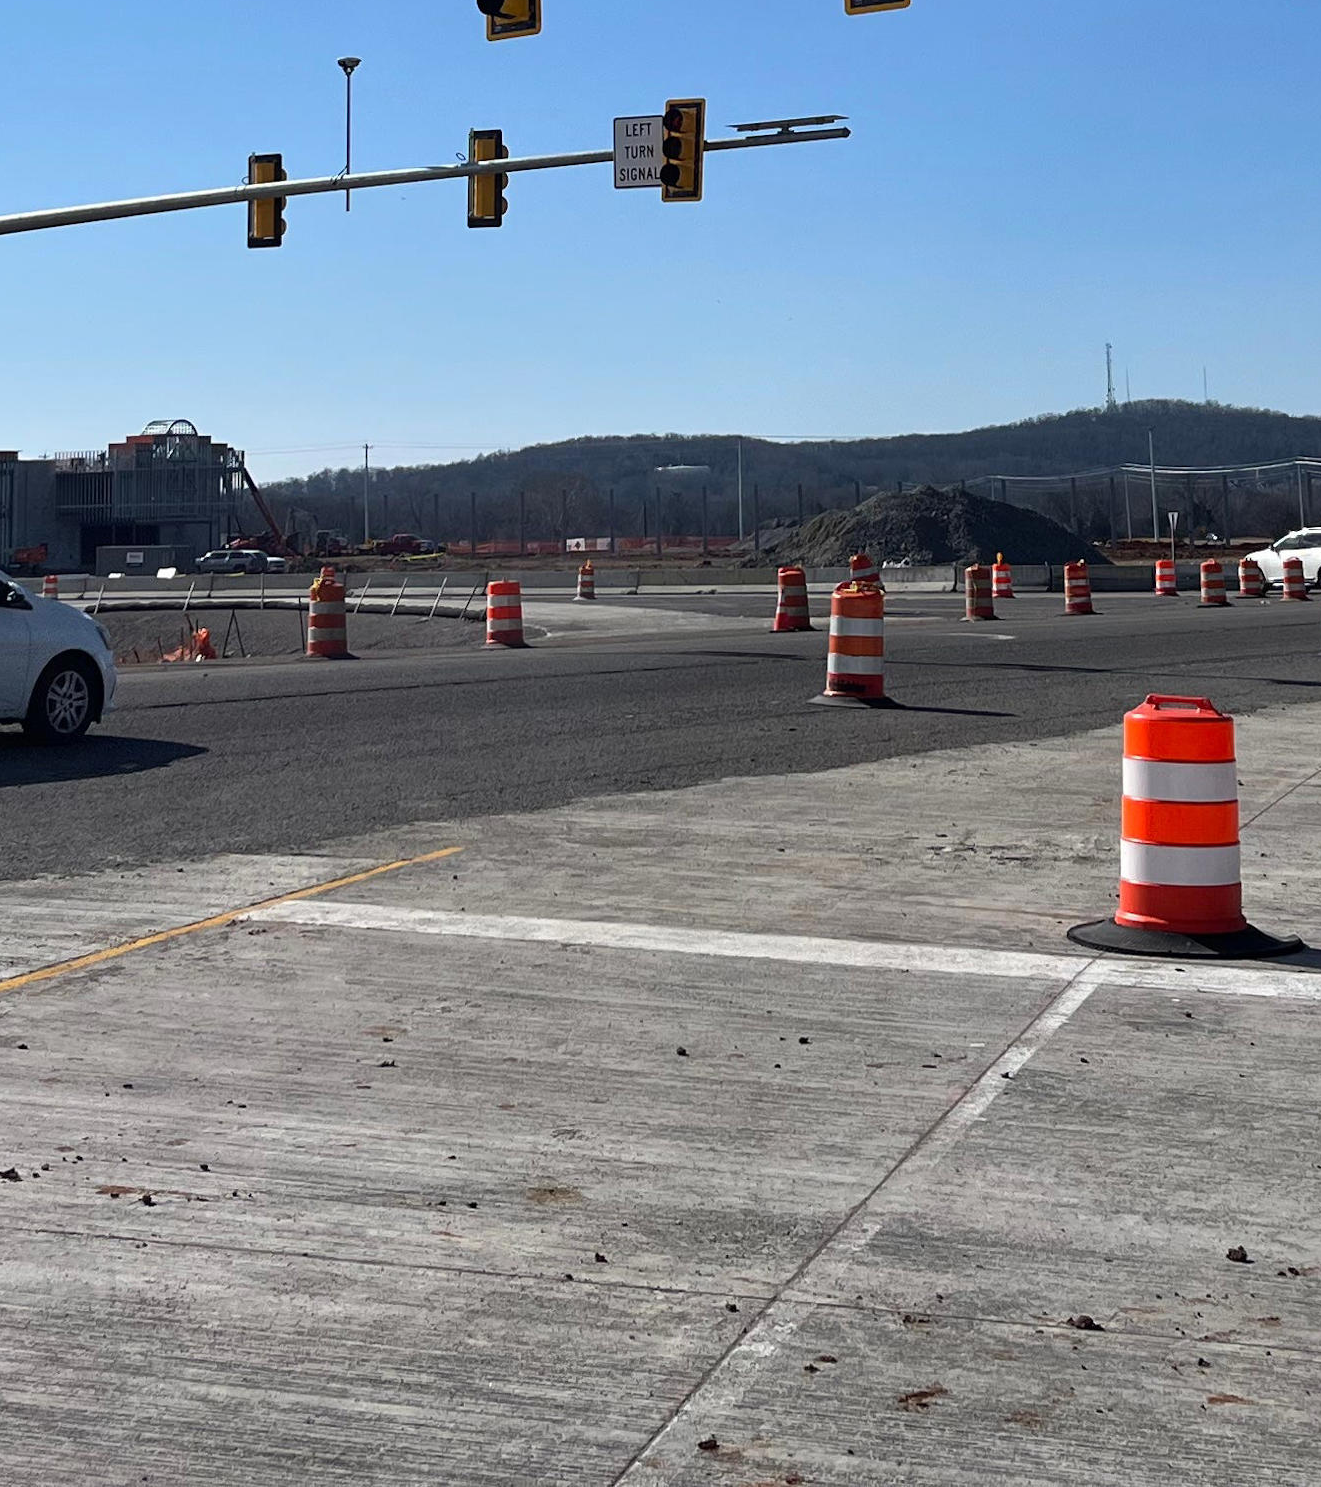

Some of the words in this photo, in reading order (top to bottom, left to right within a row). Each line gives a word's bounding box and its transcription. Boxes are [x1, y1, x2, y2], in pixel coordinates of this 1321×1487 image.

[626, 123, 652, 137] LEFT
[624, 145, 654, 159] TURN
[620, 167, 660, 181] SIGNAL
